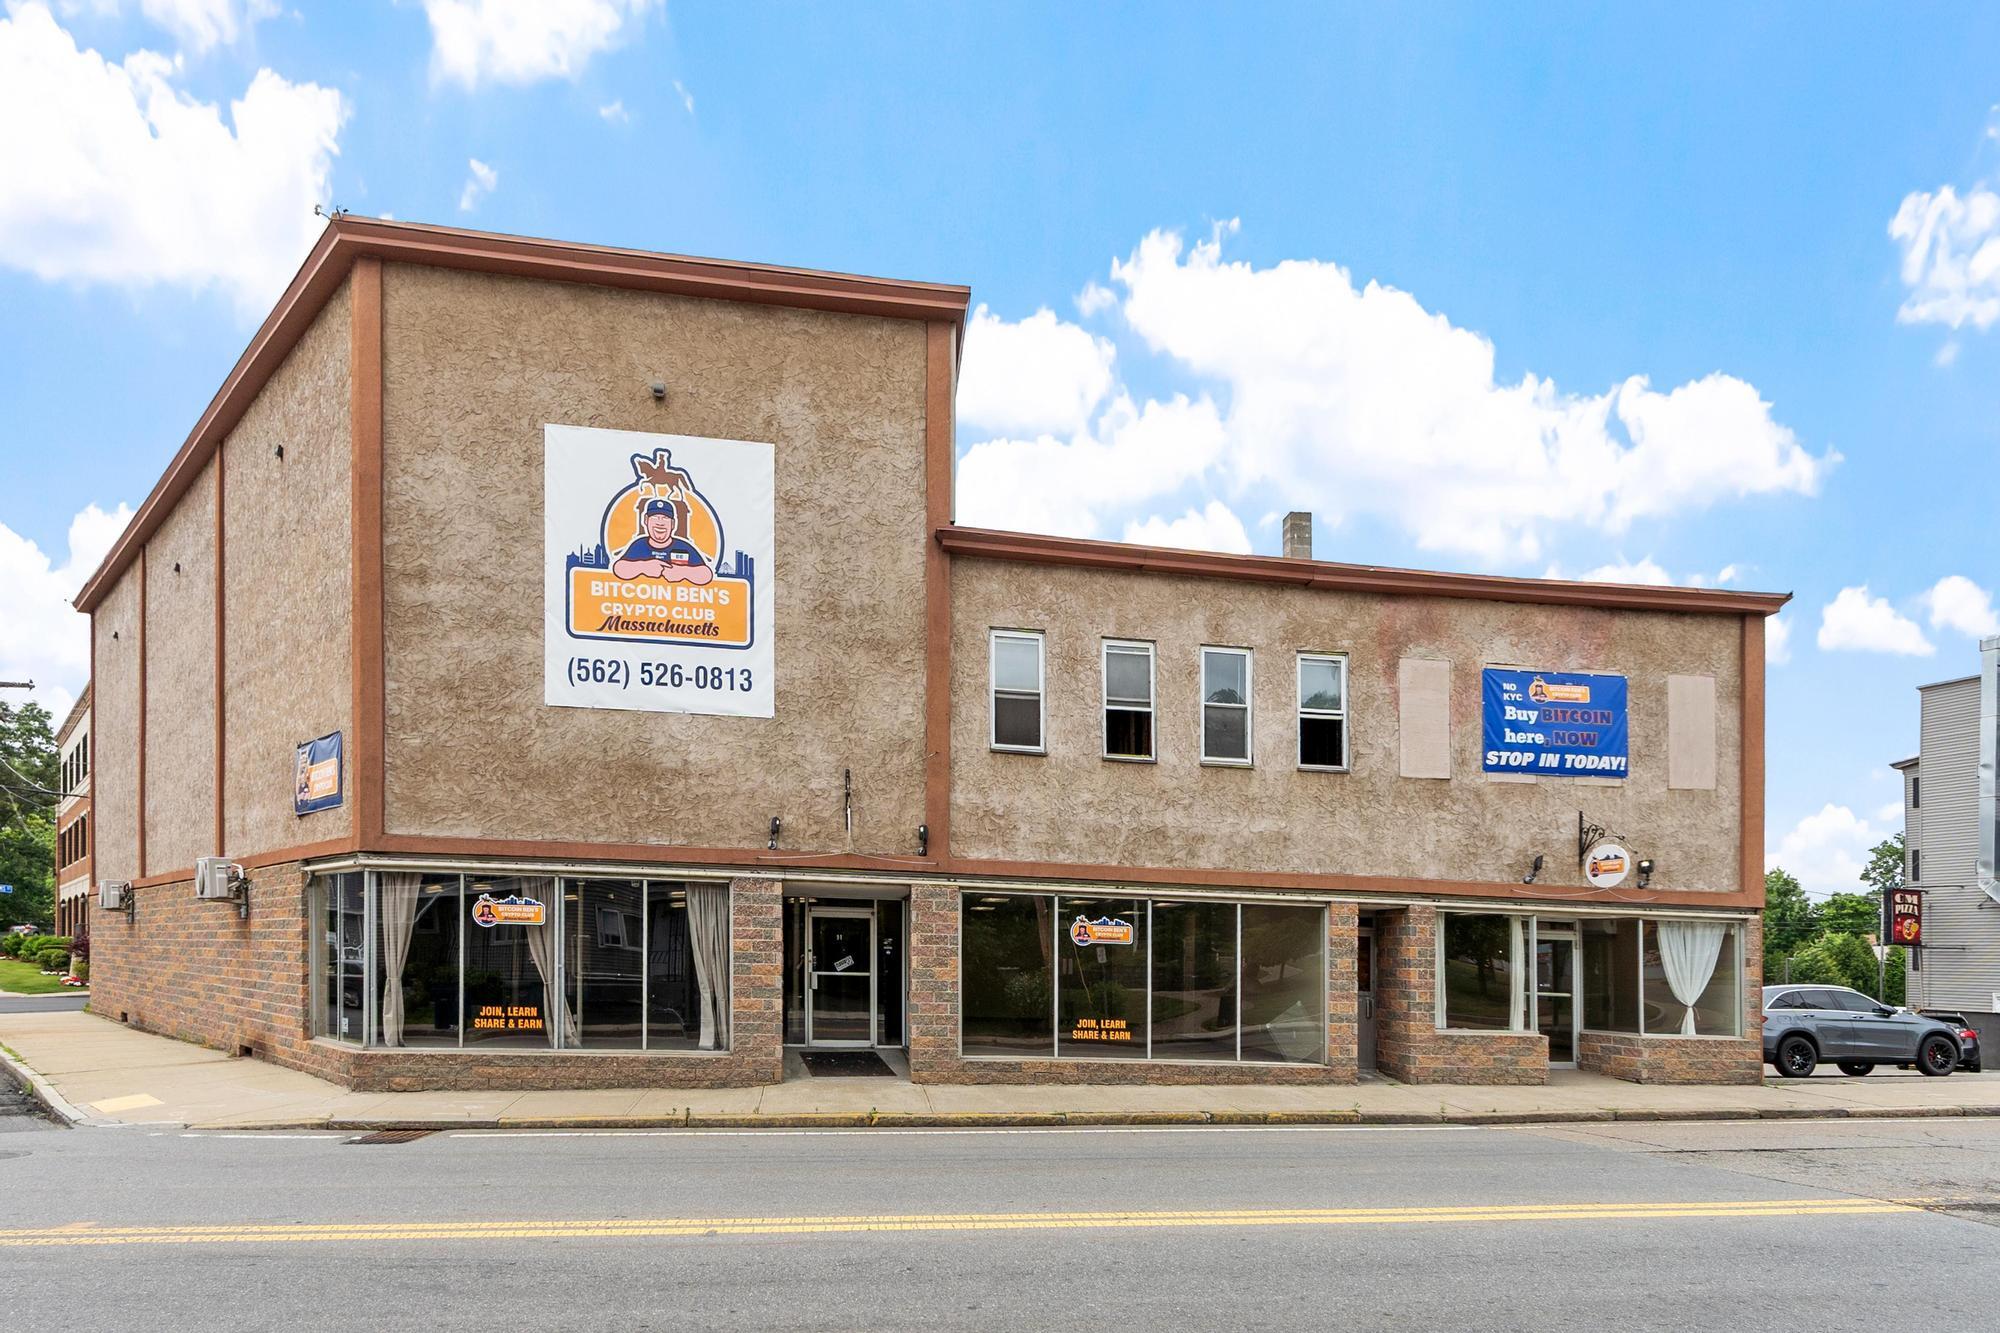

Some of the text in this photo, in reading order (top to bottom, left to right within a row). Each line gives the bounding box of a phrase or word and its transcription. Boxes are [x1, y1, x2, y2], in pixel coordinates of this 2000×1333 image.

[591, 581, 730, 605] BITCOIN BEN'S
[601, 602, 716, 621] CRYPTO CLUB
[596, 616, 720, 636] Massachusetts
[567, 657, 753, 692] (562) 526-0813
[1503, 683, 1517, 691] NO
[1503, 692, 1523, 701] KYC
[1504, 706, 1613, 725] Buy BITCOIN
[1553, 730, 1599, 747] NOW
[1485, 751, 1627, 771] STOP IN TODAY!
[1895, 904, 1919, 916] PIZZA
[480, 1006, 538, 1017] JOIN, LEARN
[474, 1019, 543, 1029] SHARE & EARN
[1077, 1019, 1127, 1029] JOIN, LEARN
[1072, 1030, 1131, 1040] SHARE & EARN
